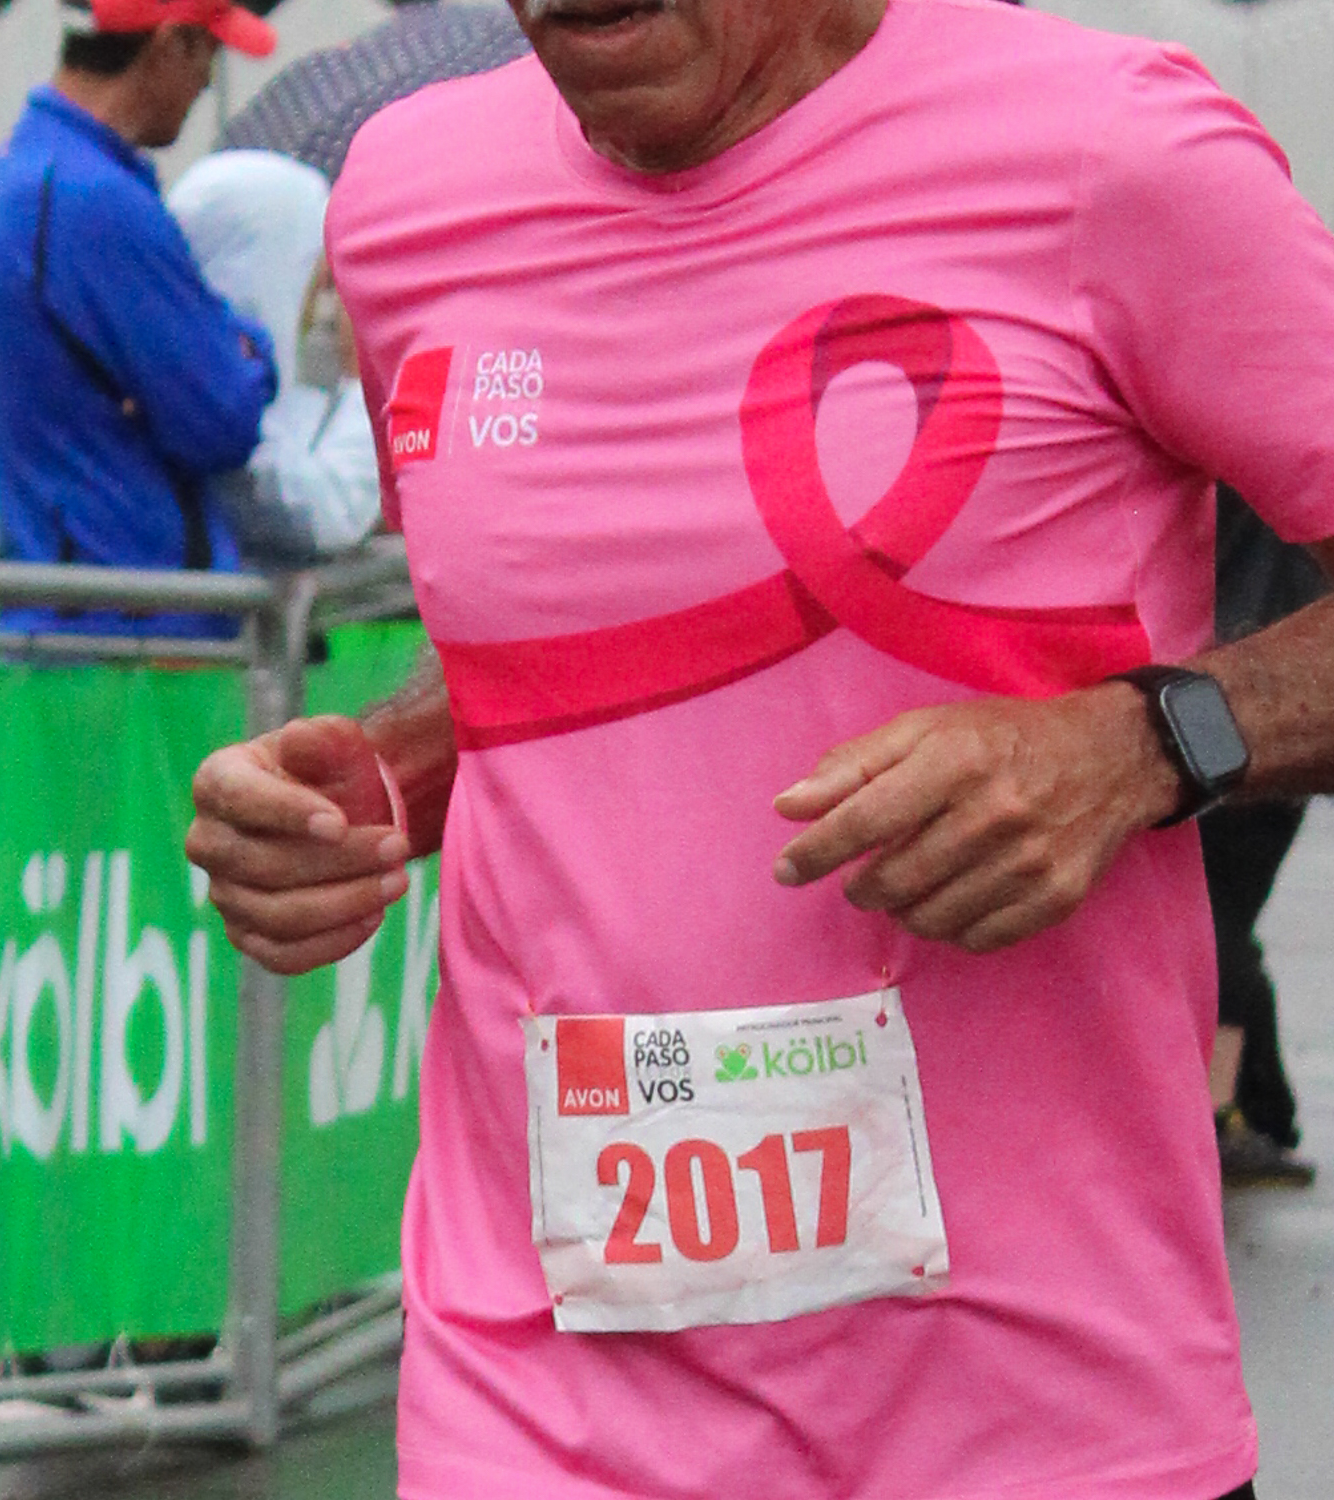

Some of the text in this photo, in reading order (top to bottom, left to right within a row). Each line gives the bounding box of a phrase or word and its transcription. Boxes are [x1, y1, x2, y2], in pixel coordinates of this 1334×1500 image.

[477, 349, 543, 373] CADA
[473, 371, 543, 400] PASO
[469, 412, 539, 447] VOS
[633, 1029, 687, 1048] CADA
[634, 1047, 690, 1067] PASO
[762, 1030, 867, 1079] kölbi
[564, 1087, 620, 1108] AVON
[638, 1079, 695, 1105] VOS
[597, 1124, 852, 1265] 2017
